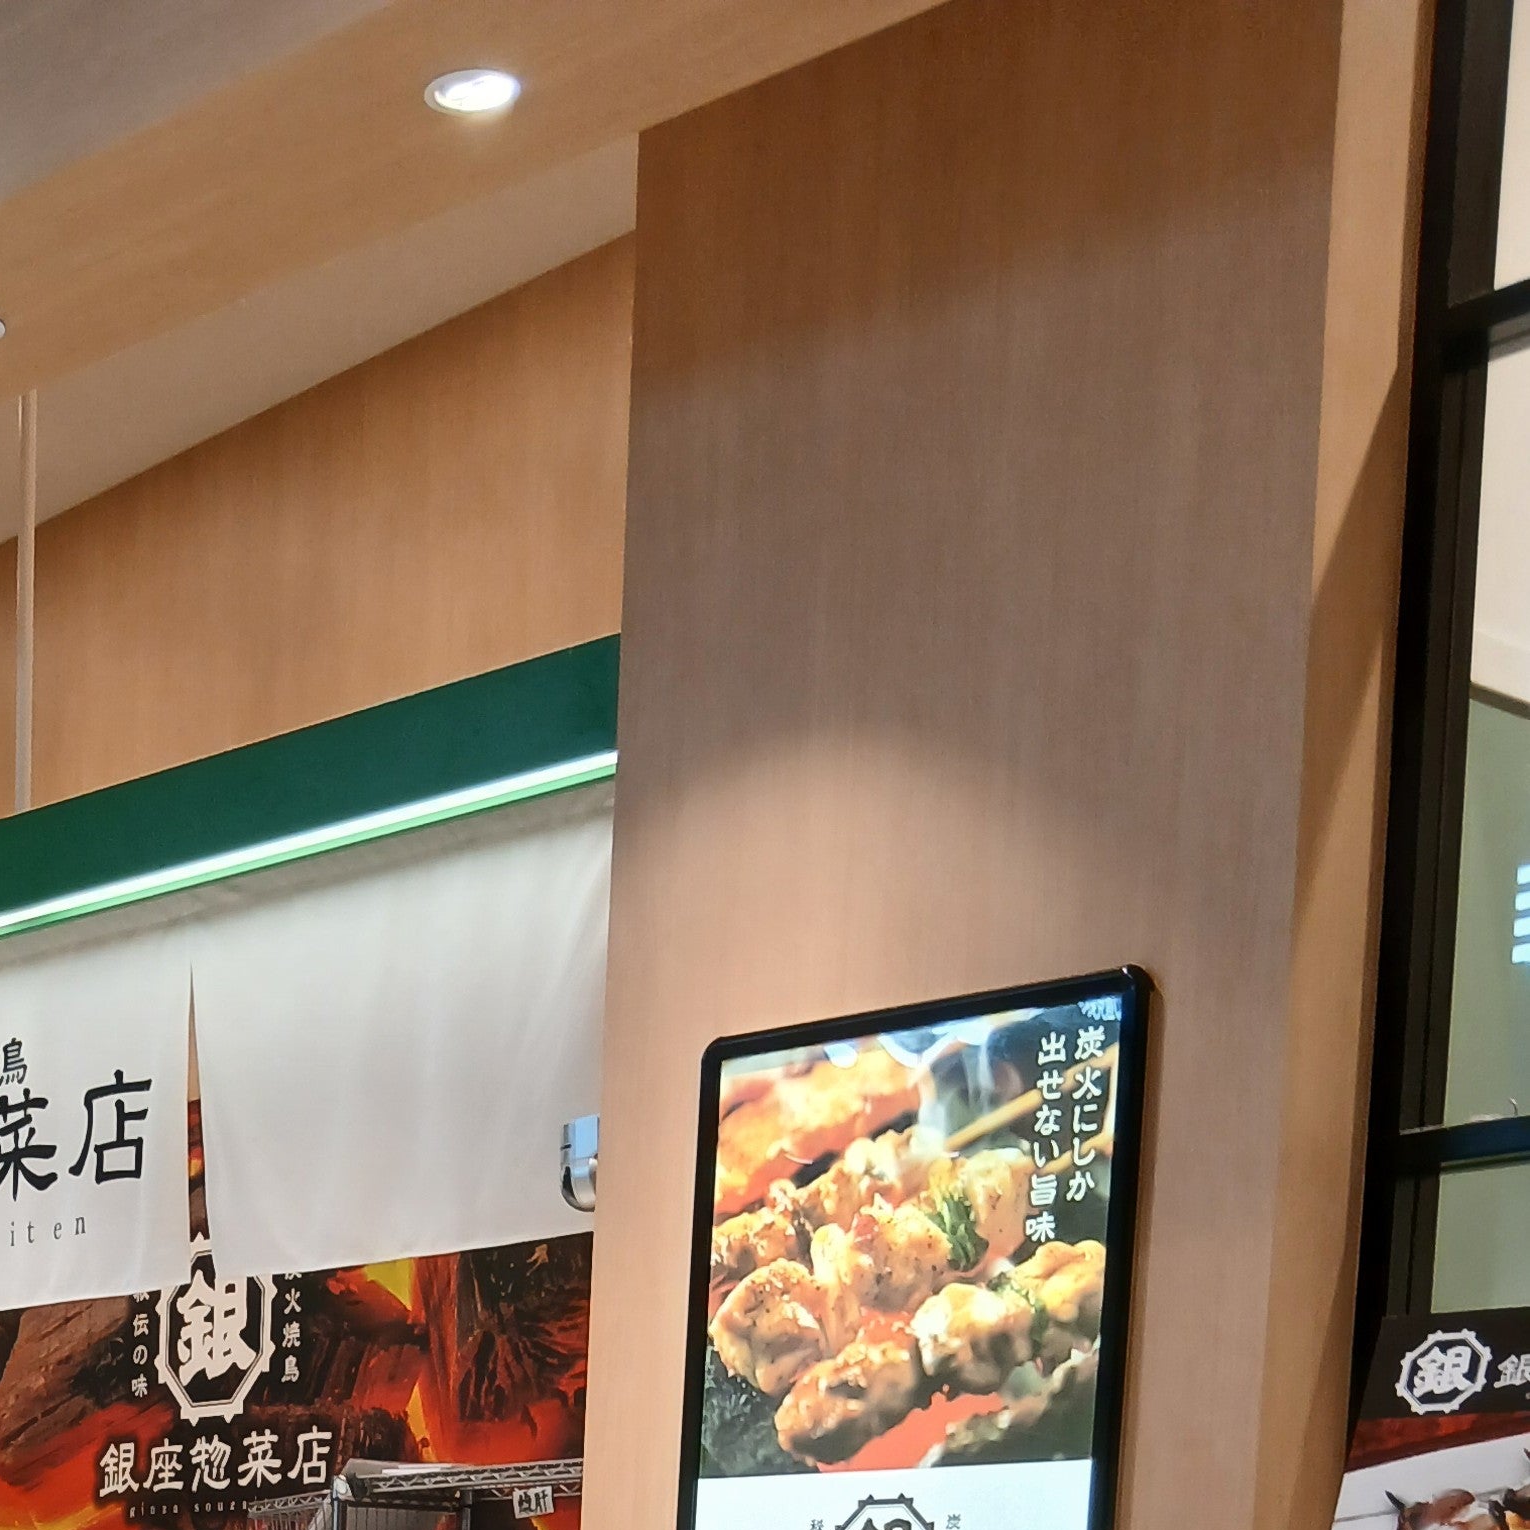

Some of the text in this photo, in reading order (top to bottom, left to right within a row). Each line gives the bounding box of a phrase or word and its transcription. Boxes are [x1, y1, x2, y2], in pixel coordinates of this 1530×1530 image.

[1022, 1030, 1068, 1243] 出せない旨味
[1064, 1024, 1107, 1202] 炭火にしか
[1412, 1345, 1476, 1399] 銀
[98, 1424, 334, 1498] 銀座惣菜店
